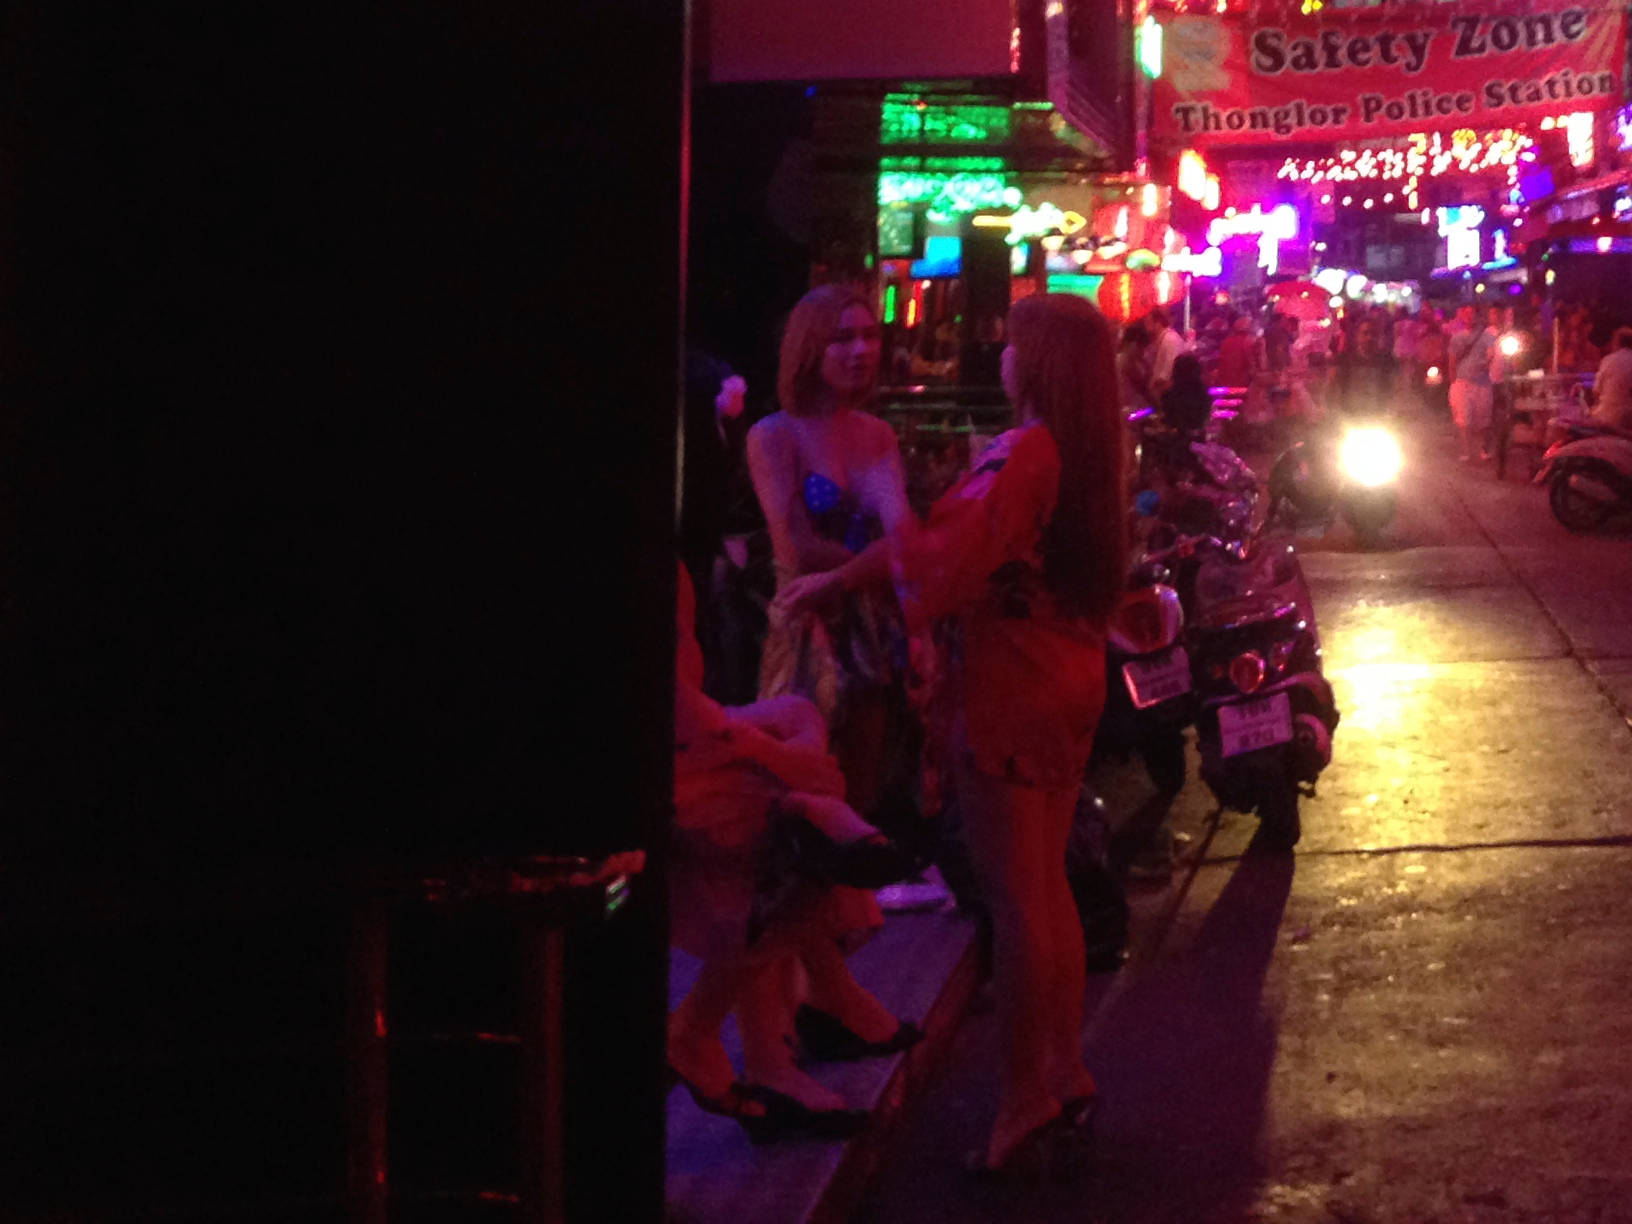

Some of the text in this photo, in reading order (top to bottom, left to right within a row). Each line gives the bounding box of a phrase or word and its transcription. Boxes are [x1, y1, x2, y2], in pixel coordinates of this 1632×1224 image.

[1251, 7, 1587, 74] Safety Zone
[1173, 67, 1616, 135] Thonglor Police Station
